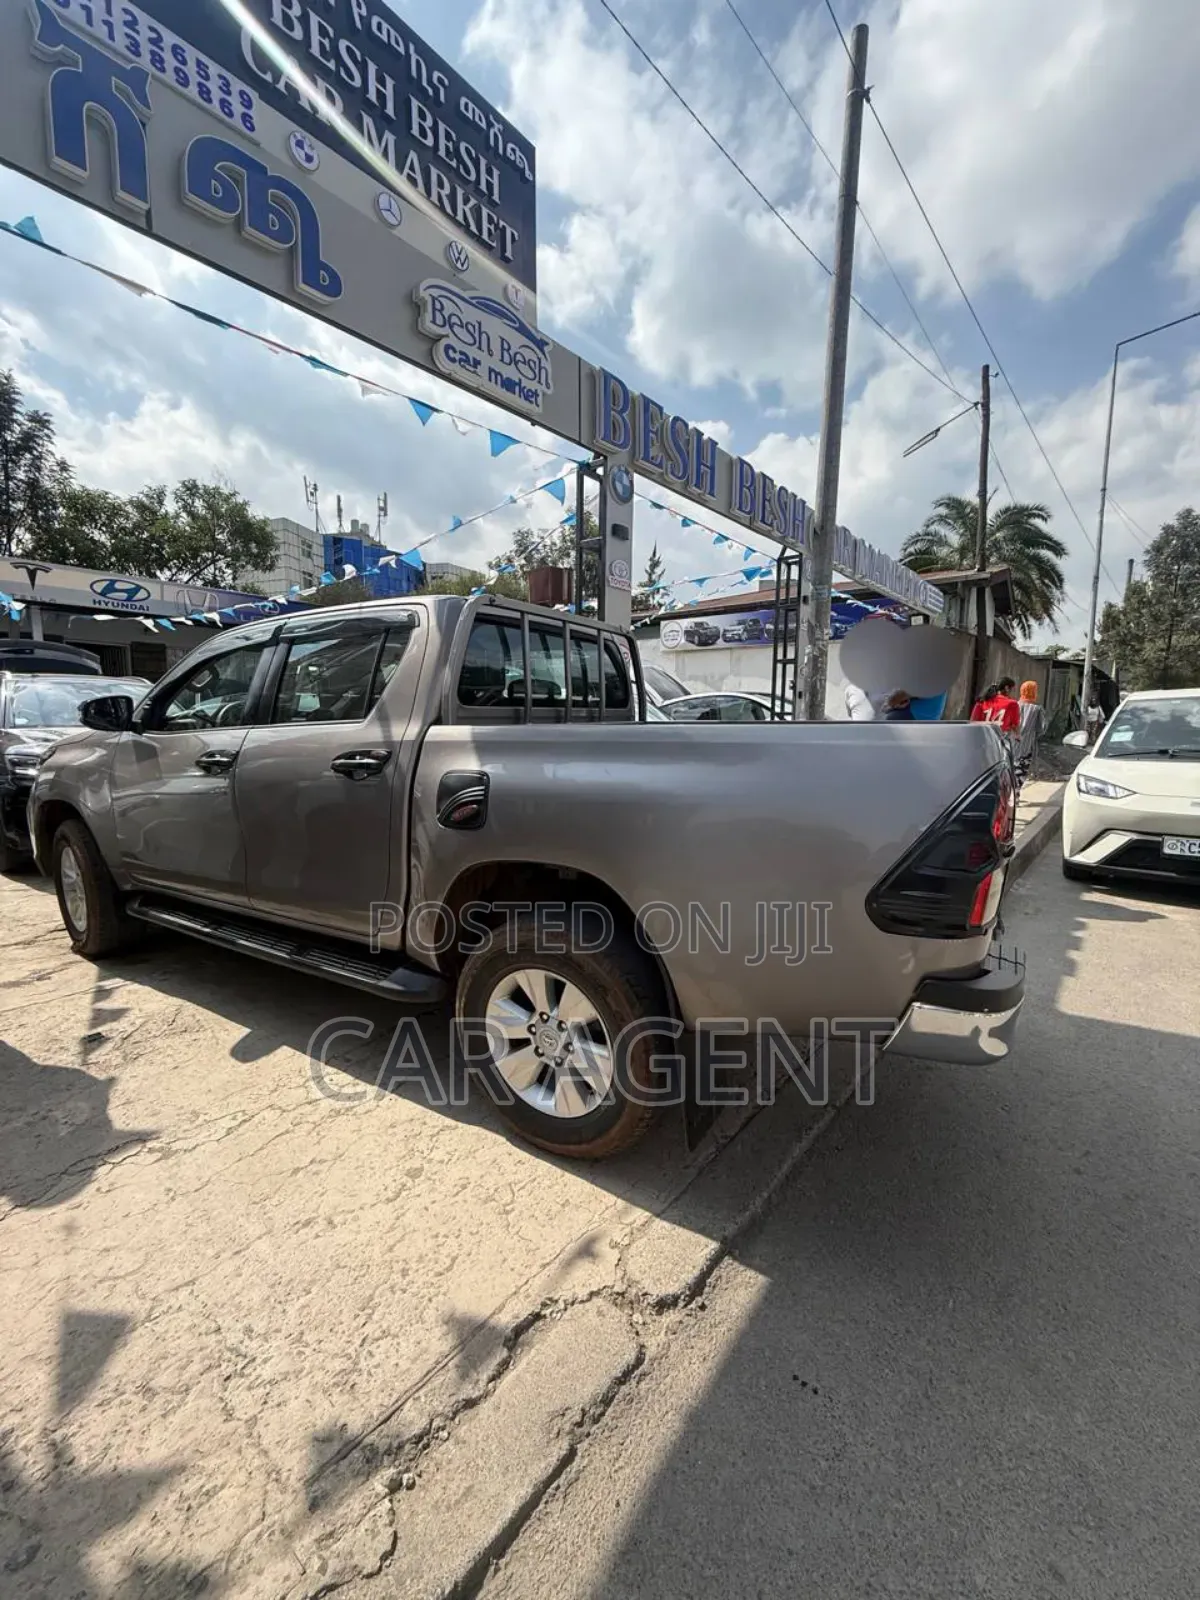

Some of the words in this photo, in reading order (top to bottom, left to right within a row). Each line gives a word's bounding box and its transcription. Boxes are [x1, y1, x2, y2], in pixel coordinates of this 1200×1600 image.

[86, 0, 253, 111] 1226539
[270, 0, 397, 120] BESH
[408, 95, 501, 204] BESH
[240, 22, 344, 126] CAR
[360, 110, 519, 262] MARKET
[429, 294, 494, 357] Besh
[499, 335, 551, 390] Besh
[443, 343, 482, 369] car
[488, 365, 540, 407] market
[600, 367, 719, 498] BESH
[736, 456, 806, 545] BESH
[93, 598, 150, 612] HYUNDAI
[983, 707, 1006, 726] 14
